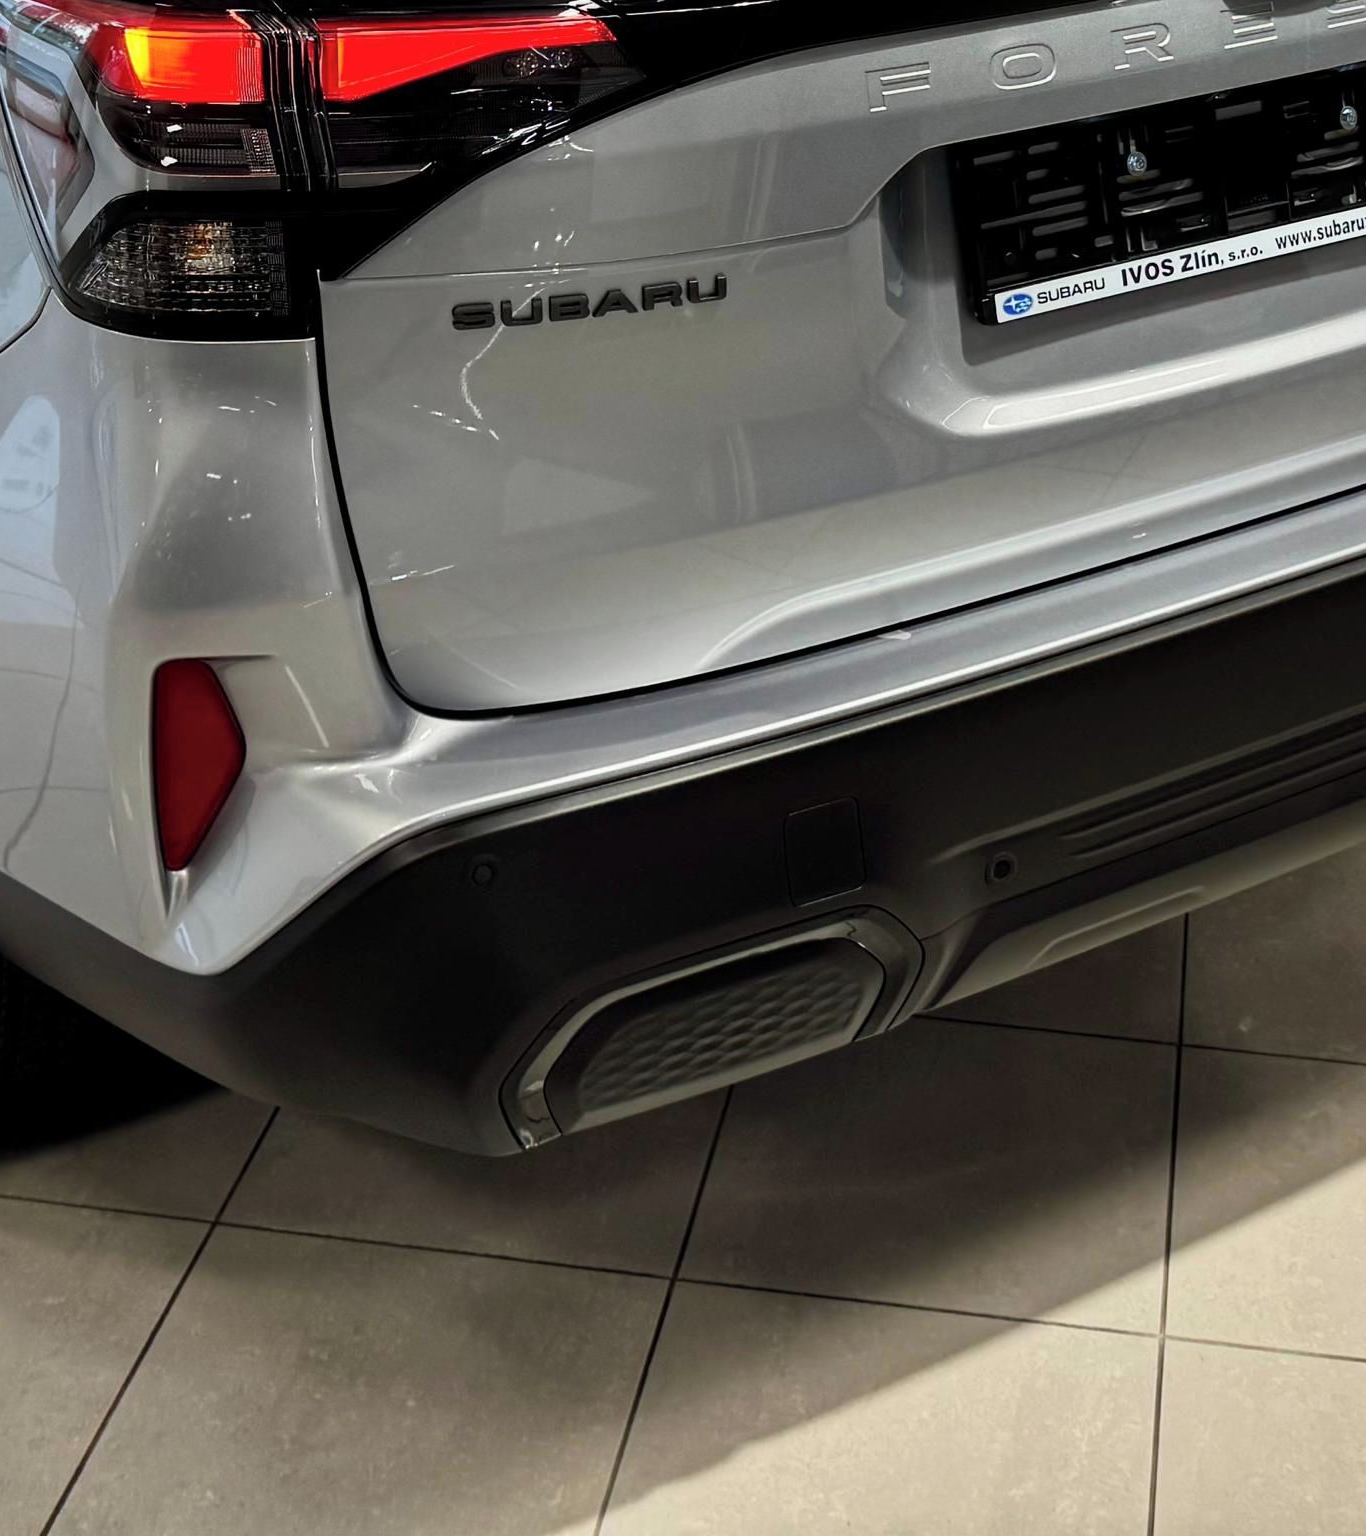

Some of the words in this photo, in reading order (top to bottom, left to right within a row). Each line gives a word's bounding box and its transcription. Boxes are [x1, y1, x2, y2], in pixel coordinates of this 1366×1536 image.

[452, 272, 728, 330] SUBARU
[1037, 277, 1106, 305] SUBARU
[1121, 257, 1175, 287] IVOS
[1181, 248, 1225, 273] Zlín,
[1228, 246, 1264, 262] s.r.o.
